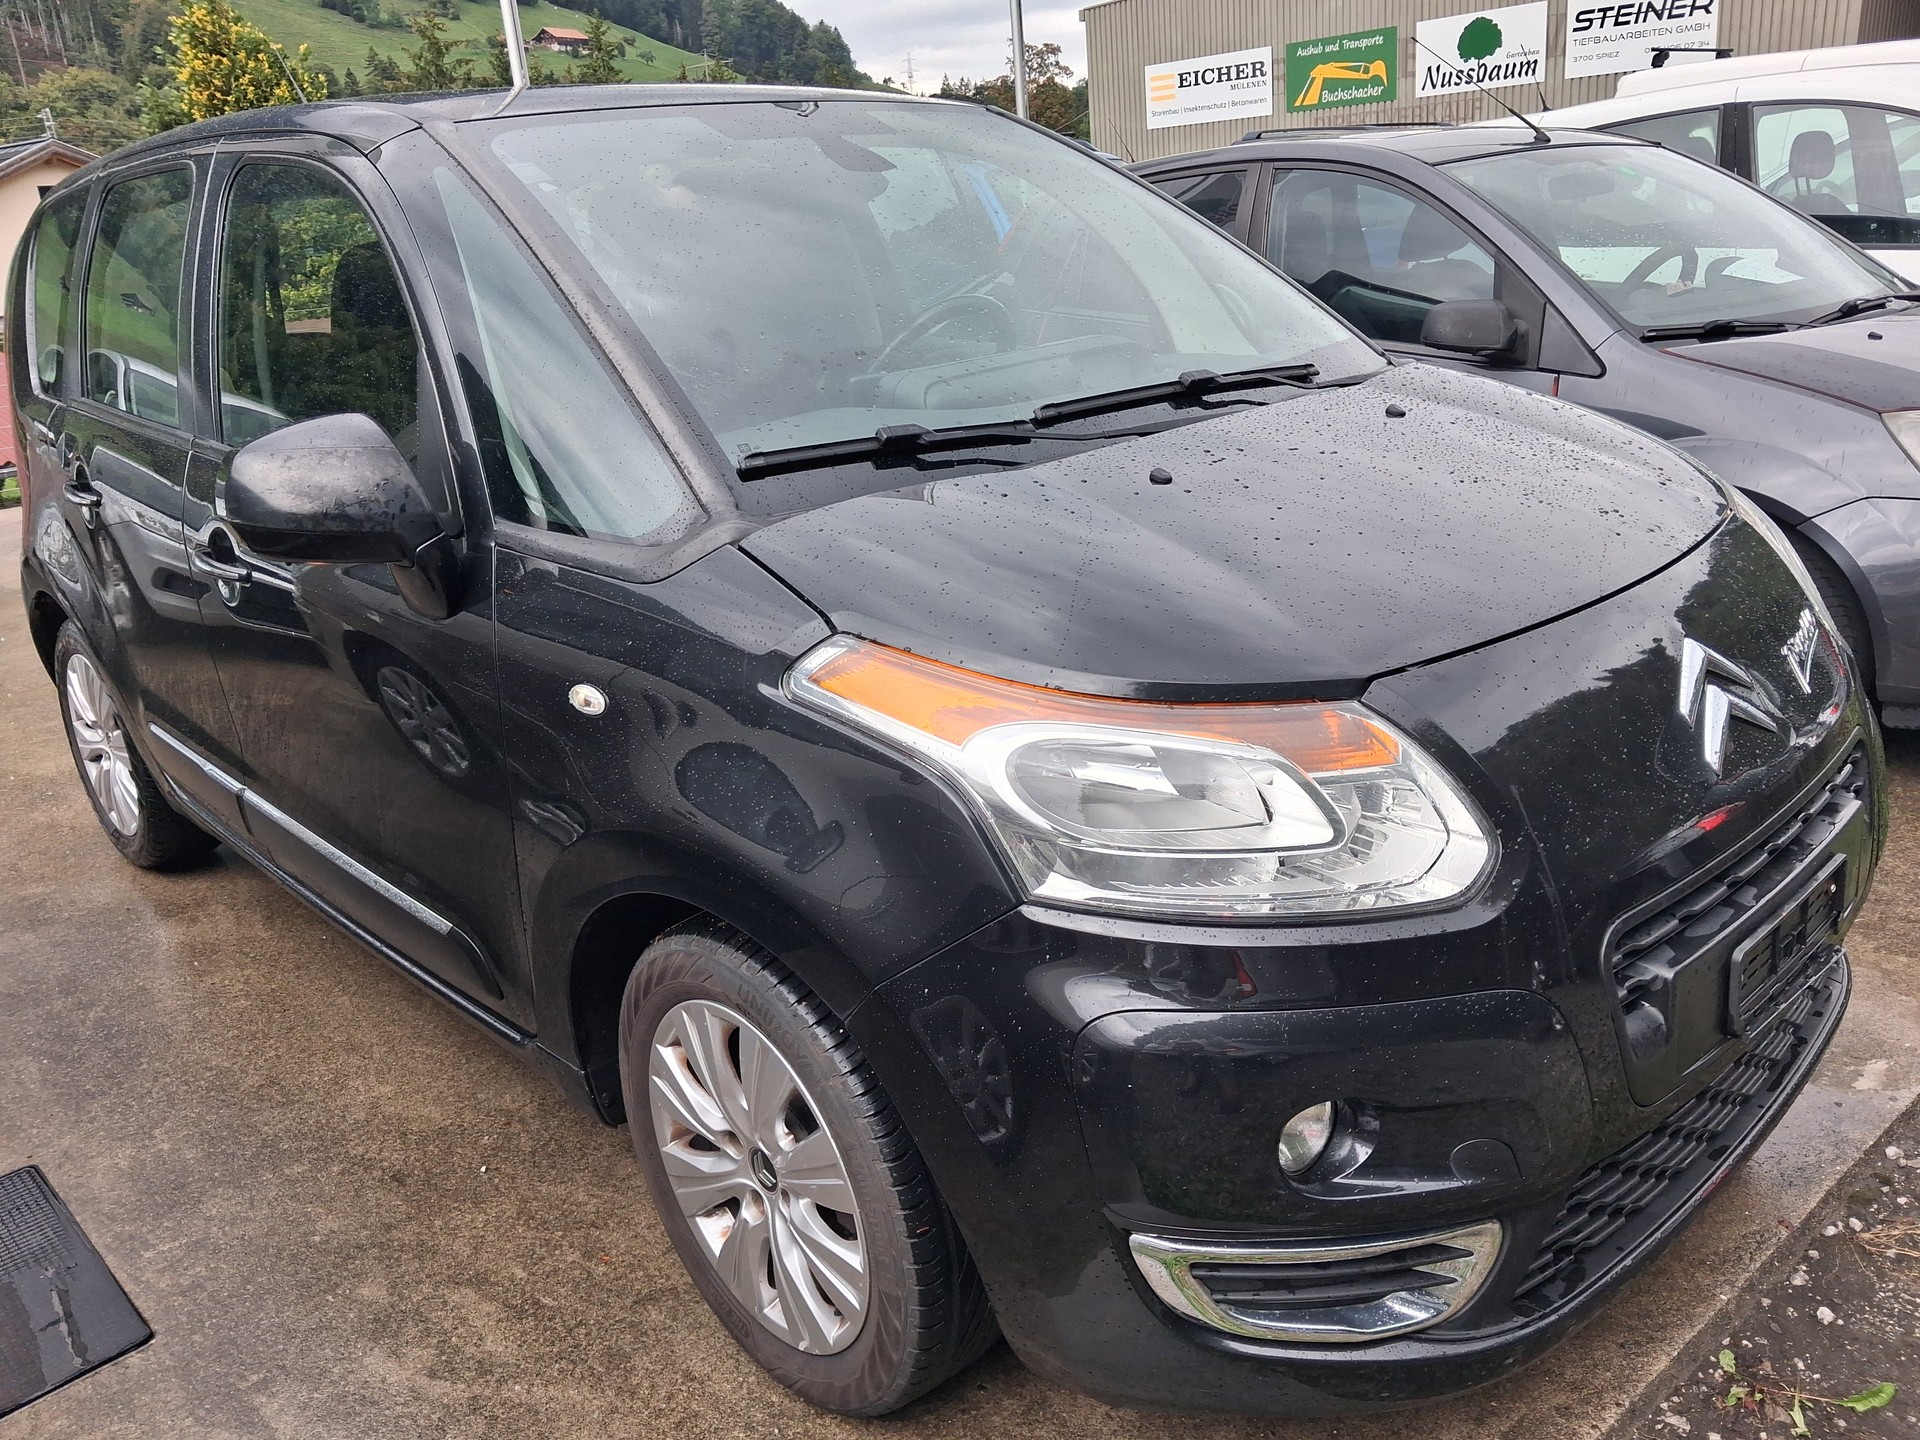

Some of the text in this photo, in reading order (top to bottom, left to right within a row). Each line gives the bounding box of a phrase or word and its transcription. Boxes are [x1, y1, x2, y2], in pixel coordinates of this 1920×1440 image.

[1572, 0, 1713, 33] STEINER
[1297, 34, 1384, 57] Aushub und Transporte
[1573, 22, 1711, 46] TIEFBAUARBEITEN GMBH
[1506, 48, 1540, 59] Gartenbau
[1573, 51, 1620, 63] 3700 SPIEZ
[1177, 61, 1267, 88] EICHER
[1421, 58, 1538, 91] Nussbaum
[1322, 83, 1384, 103] Buchschacher
[1151, 97, 1267, 117] Storenbau Insektenschutz Betonwaren
